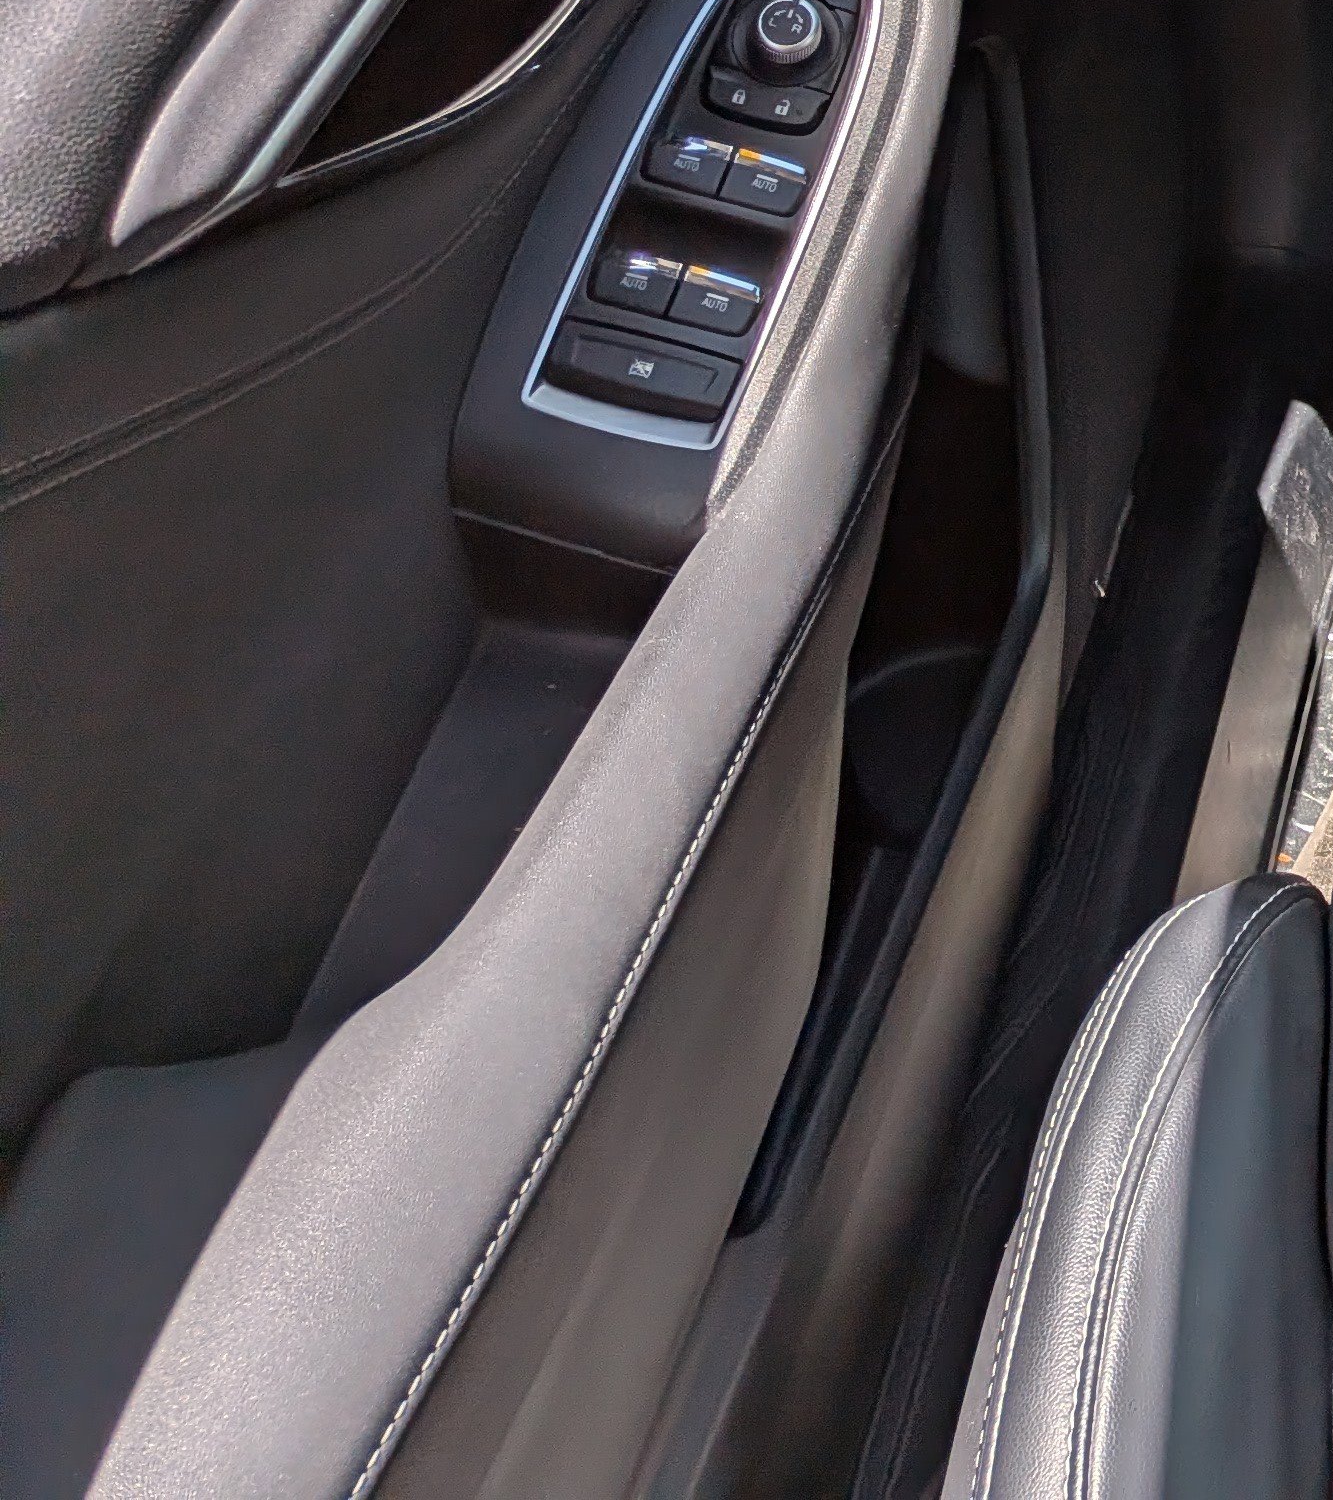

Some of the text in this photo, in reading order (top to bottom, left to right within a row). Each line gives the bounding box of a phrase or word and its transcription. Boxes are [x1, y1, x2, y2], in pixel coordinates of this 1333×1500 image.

[674, 156, 700, 172] AUTO
[751, 177, 778, 193] AUTO
[620, 276, 648, 291] AUTO
[701, 295, 728, 313] AUTO
